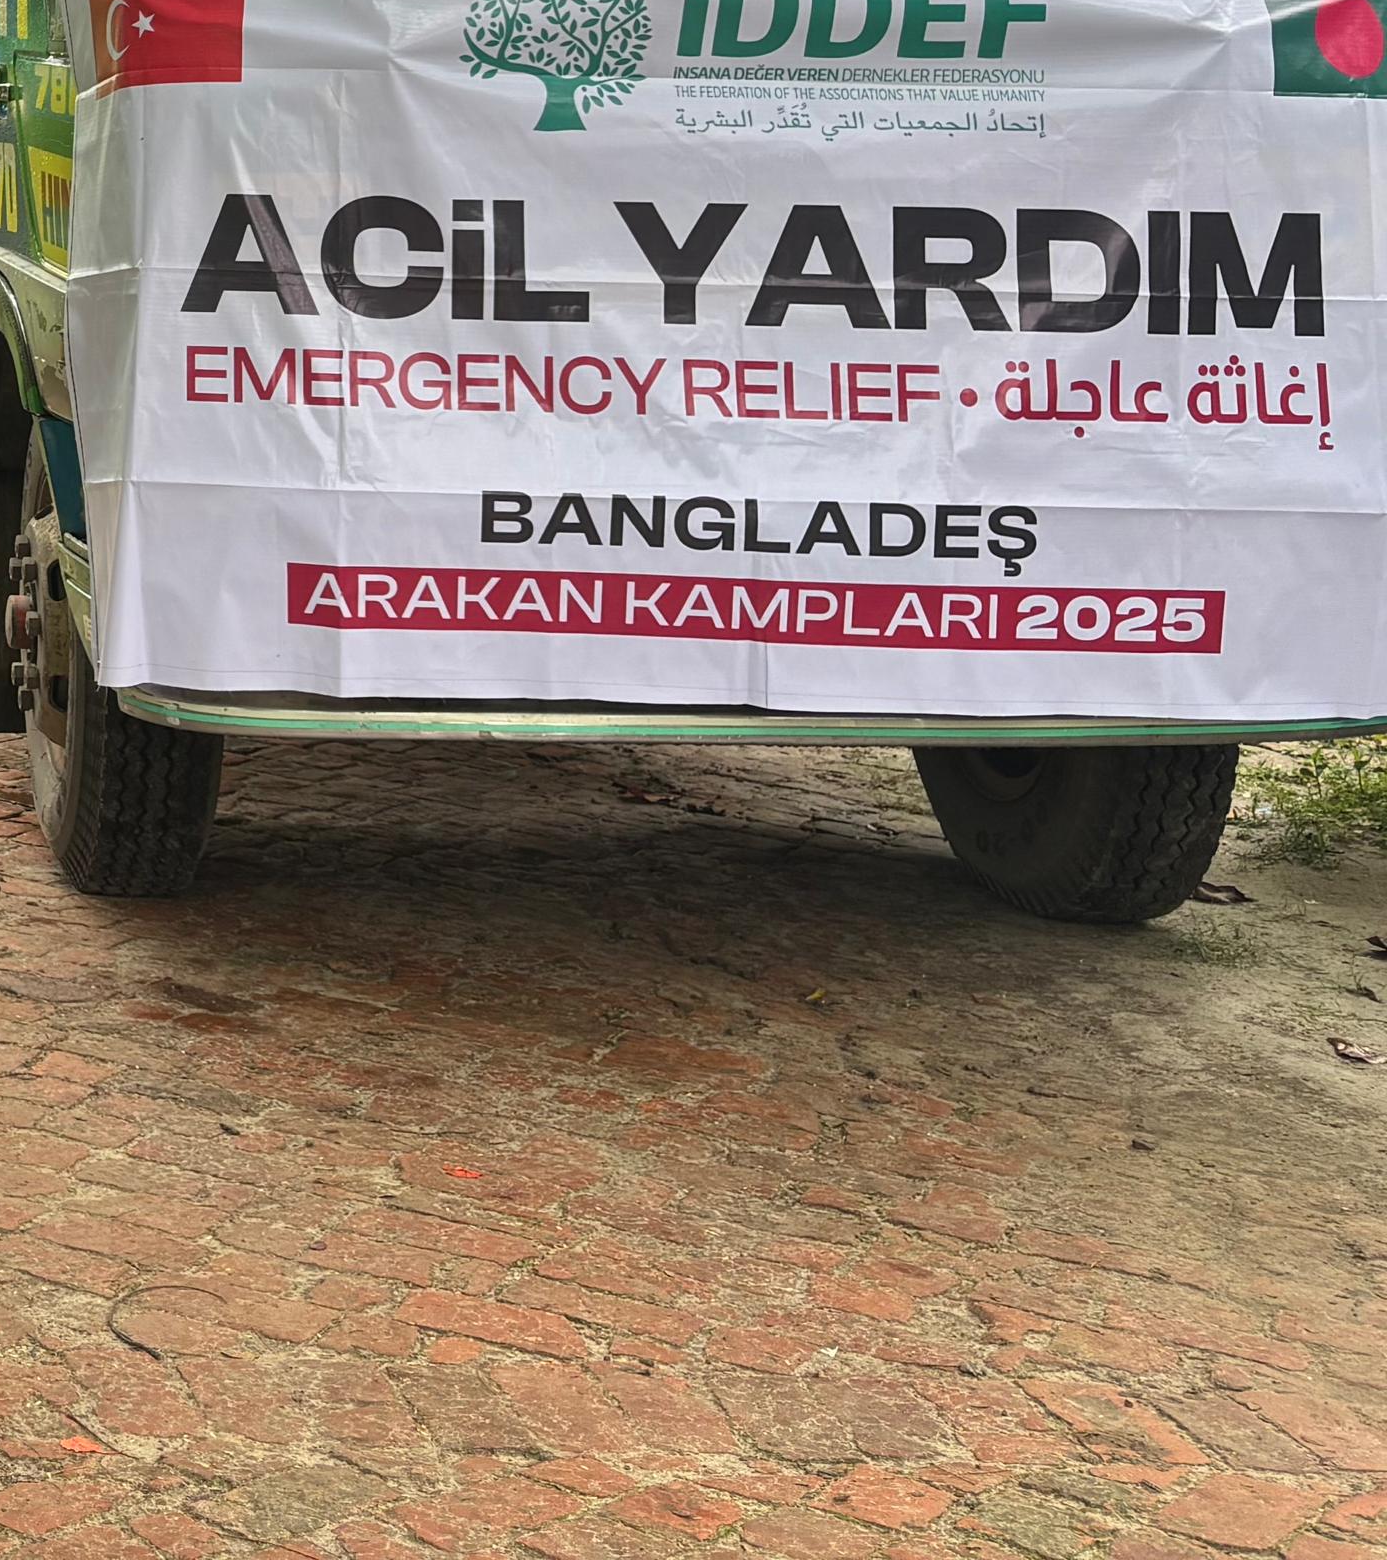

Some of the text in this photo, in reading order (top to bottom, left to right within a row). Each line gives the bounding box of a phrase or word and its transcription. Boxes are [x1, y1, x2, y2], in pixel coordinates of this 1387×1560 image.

[675, 85, 1046, 103] THE FEDERATION OF THE ASSOCIATIONS THAT VALUE HUMANITY
[734, 63, 785, 81] DEĞER
[787, 67, 840, 82] VEREN
[841, 67, 930, 83] DERNEKLER
[933, 68, 1045, 84] FEDERASYONU
[675, 108, 753, 135] البشرية
[821, 111, 865, 141] التي
[873, 111, 978, 137] الجمعيات
[615, 200, 1326, 339] YARDIM
[186, 345, 941, 425] EMERGENCY RELIEF
[995, 354, 1334, 450] إغاثة عاجلة
[479, 490, 1038, 577] BANGLADEŞ
[304, 571, 1207, 643] ARAKAN KAMPLARI 2025
